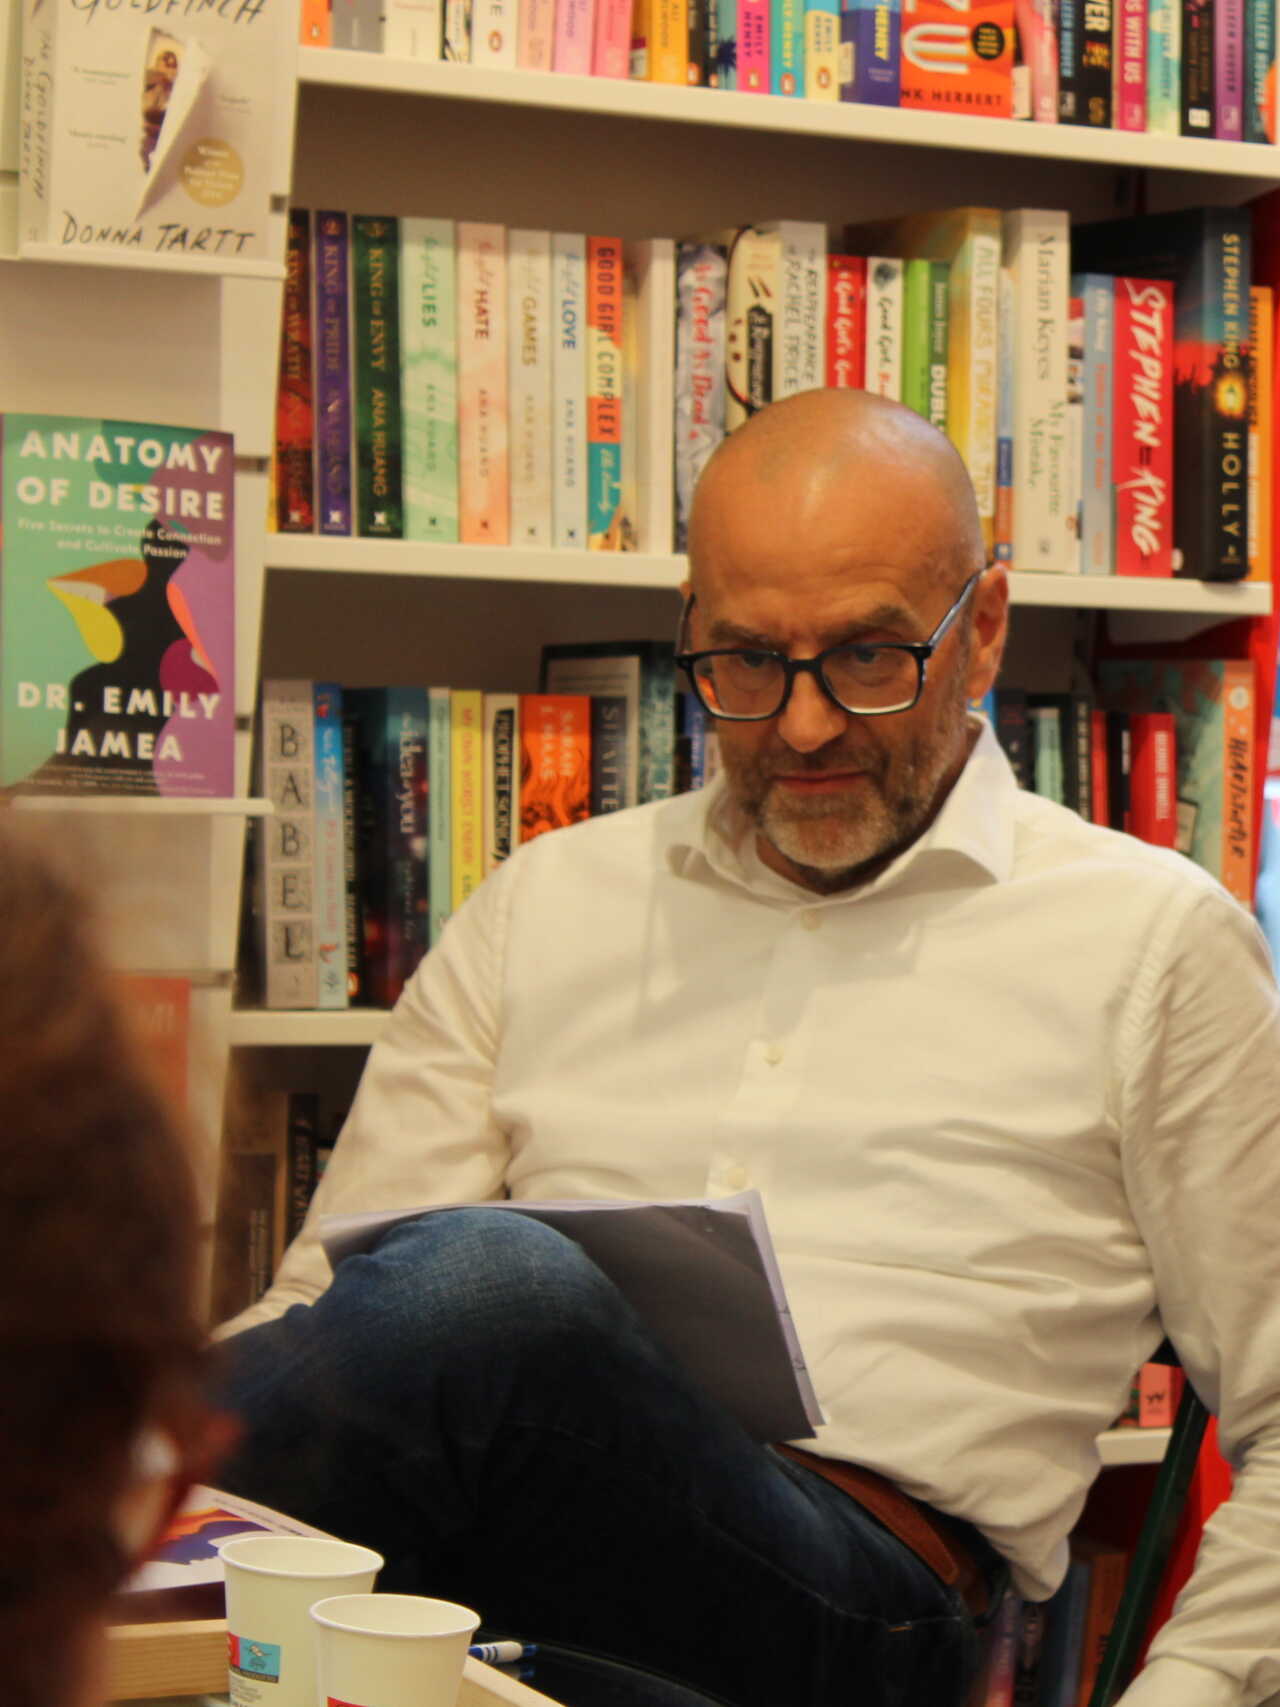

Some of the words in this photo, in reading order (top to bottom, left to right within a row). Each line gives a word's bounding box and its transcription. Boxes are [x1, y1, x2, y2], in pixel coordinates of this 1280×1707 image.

[755, 15, 764, 56] EMILY
[874, 4, 890, 60] HENRY
[1124, 16, 1143, 60] WITH
[1123, 61, 1142, 85] US
[62, 209, 143, 245] DONNA
[154, 223, 256, 253] TARTT
[368, 248, 384, 297] KING
[597, 246, 616, 296] GOOD
[1037, 233, 1056, 312] Marian
[1222, 233, 1241, 317] STEPHEN
[421, 283, 438, 329] LIES
[474, 290, 490, 340] HATE
[561, 299, 577, 350] LOVE
[598, 302, 615, 344] GIRL
[369, 320, 385, 371] ENVY
[521, 297, 537, 367] GAMES
[1034, 317, 1055, 381] Keyes
[1222, 320, 1241, 369] KING
[1124, 280, 1168, 448] STEPHEN
[371, 388, 387, 428] ANA
[598, 351, 615, 437] COMPLEX
[20, 430, 223, 475] ANATOMY
[373, 431, 389, 497] HUANG
[16, 475, 71, 506] OF
[88, 480, 224, 521] DESIRE
[1221, 431, 1242, 537] HOLLY
[17, 518, 44, 530] Five
[157, 528, 222, 546] Connection
[1118, 468, 1167, 556] KING
[143, 546, 187, 559] Passion
[17, 681, 86, 713] DR.
[103, 686, 221, 720] EMILY
[601, 706, 619, 811] SHATTE
[395, 791, 416, 834] you
[278, 722, 305, 964] BABEL
